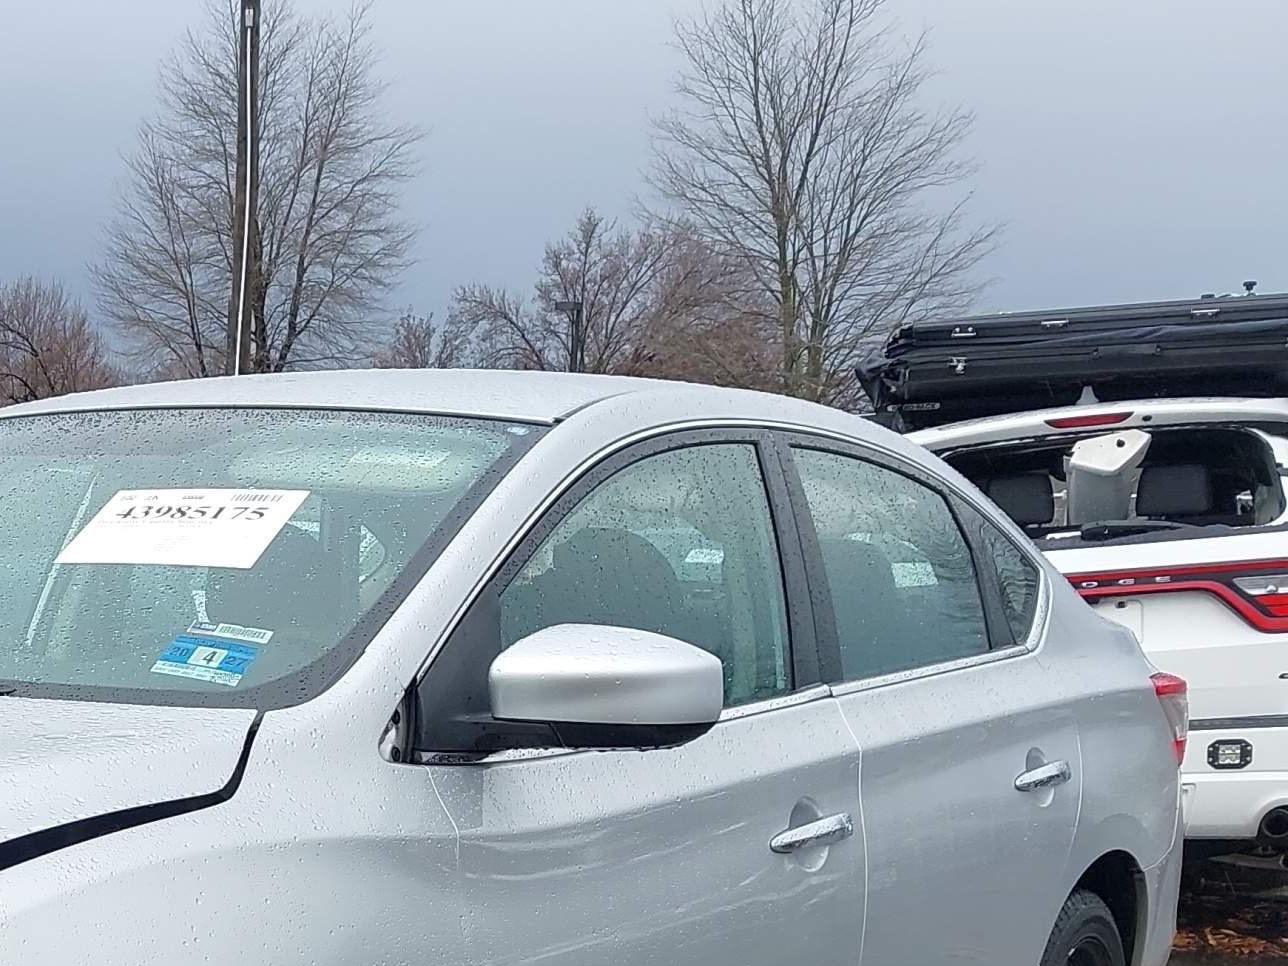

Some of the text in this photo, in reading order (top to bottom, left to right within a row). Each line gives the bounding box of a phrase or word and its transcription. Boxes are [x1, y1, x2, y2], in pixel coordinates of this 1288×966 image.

[115, 505, 271, 520] 43985175
[168, 646, 189, 657] 20
[201, 650, 218, 665] 4
[225, 655, 249, 667] 27
